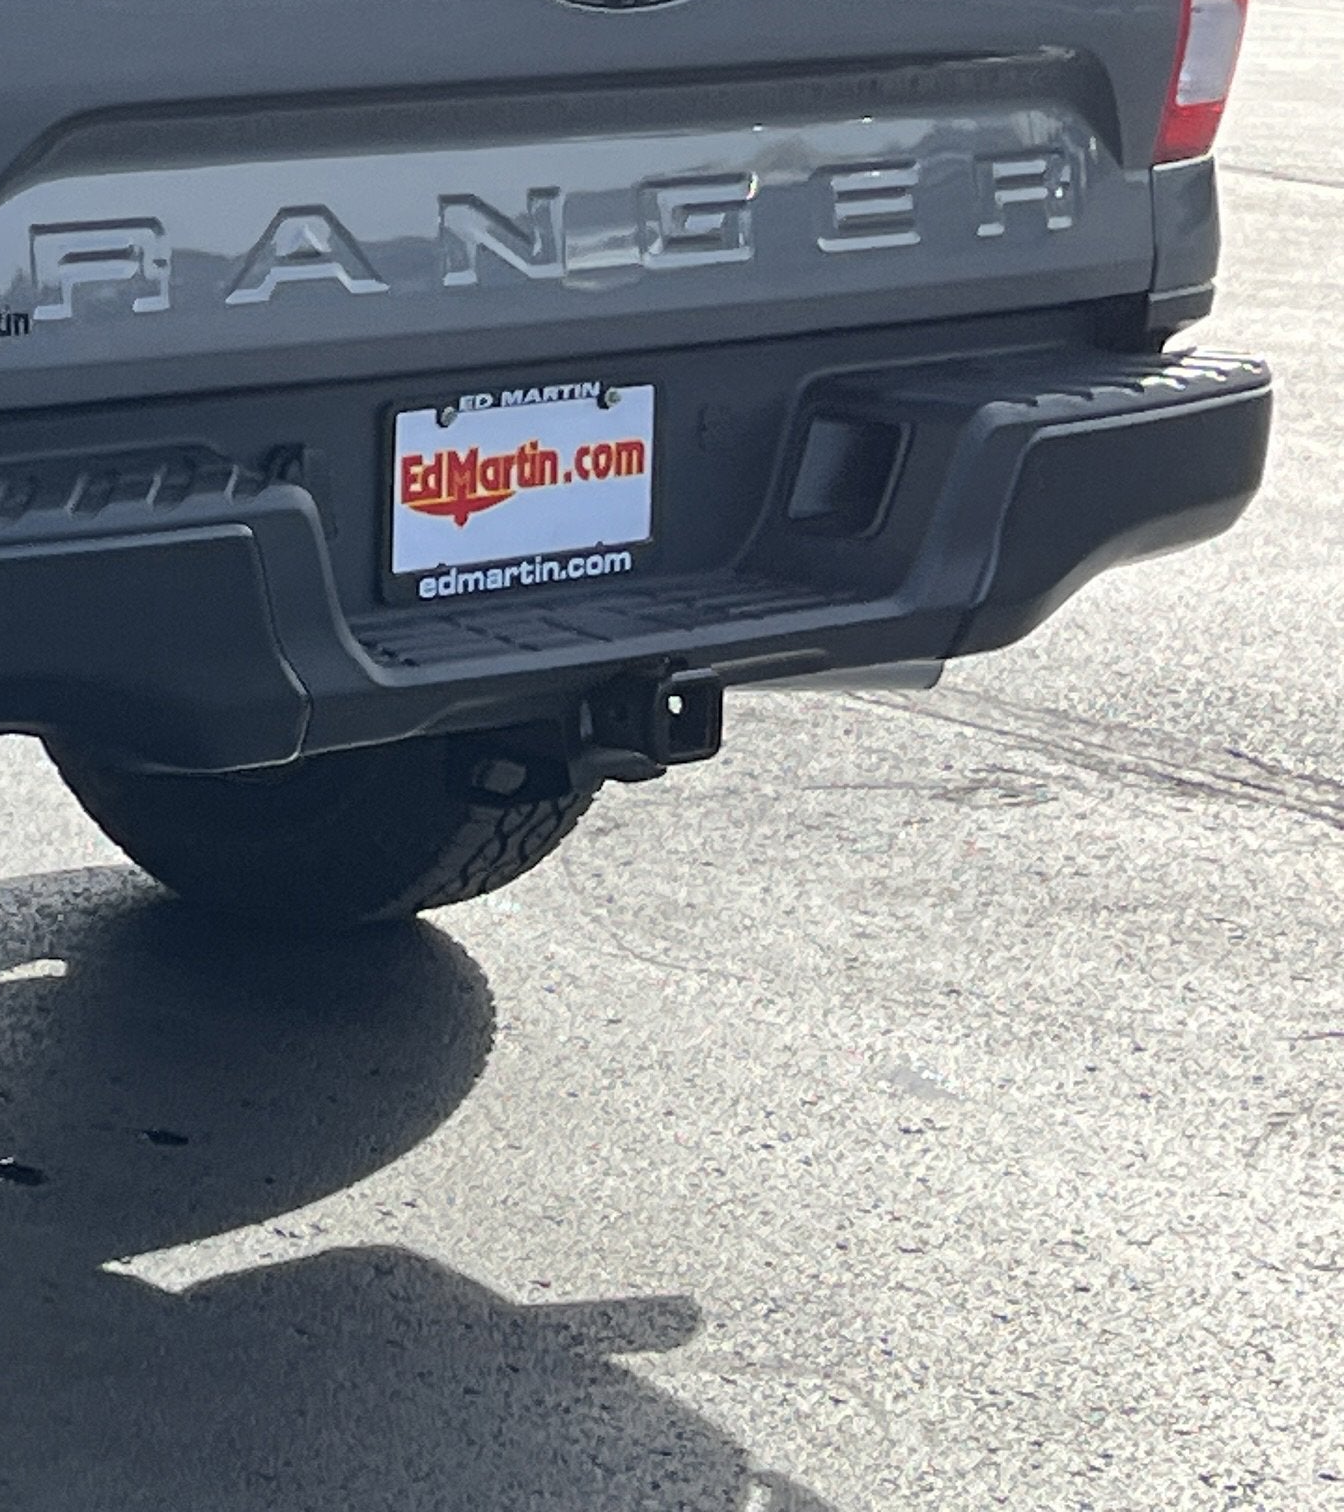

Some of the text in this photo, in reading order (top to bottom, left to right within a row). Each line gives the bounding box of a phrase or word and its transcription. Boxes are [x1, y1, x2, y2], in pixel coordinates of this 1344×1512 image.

[28, 146, 1080, 322] RANGER
[458, 381, 601, 412] ED MARTIN
[418, 550, 633, 600] edmartin.com
